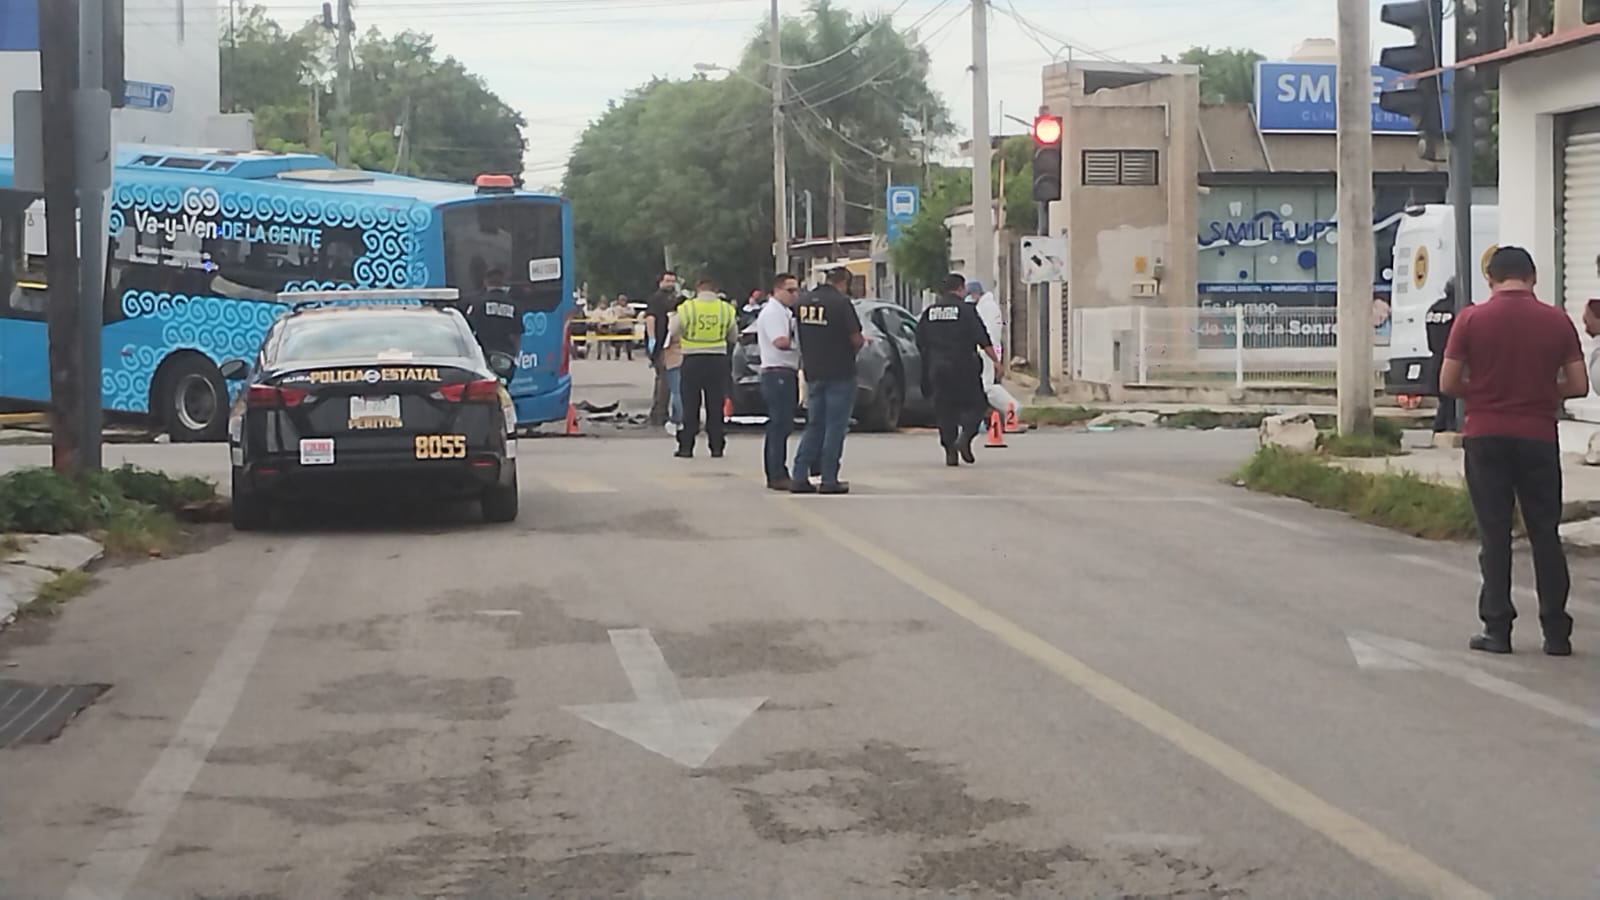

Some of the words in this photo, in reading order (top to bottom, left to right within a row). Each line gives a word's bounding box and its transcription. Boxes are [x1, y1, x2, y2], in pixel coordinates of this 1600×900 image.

[1277, 74, 1385, 104] SME
[134, 209, 218, 242] Va-y-Ven
[222, 221, 243, 240] DE
[246, 222, 267, 243] LA
[268, 225, 322, 249] GENTE
[309, 369, 365, 383] POLICIA
[381, 368, 443, 382] ESTATAL
[1006, 410, 1015, 425] 2
[414, 435, 467, 459] 8055
